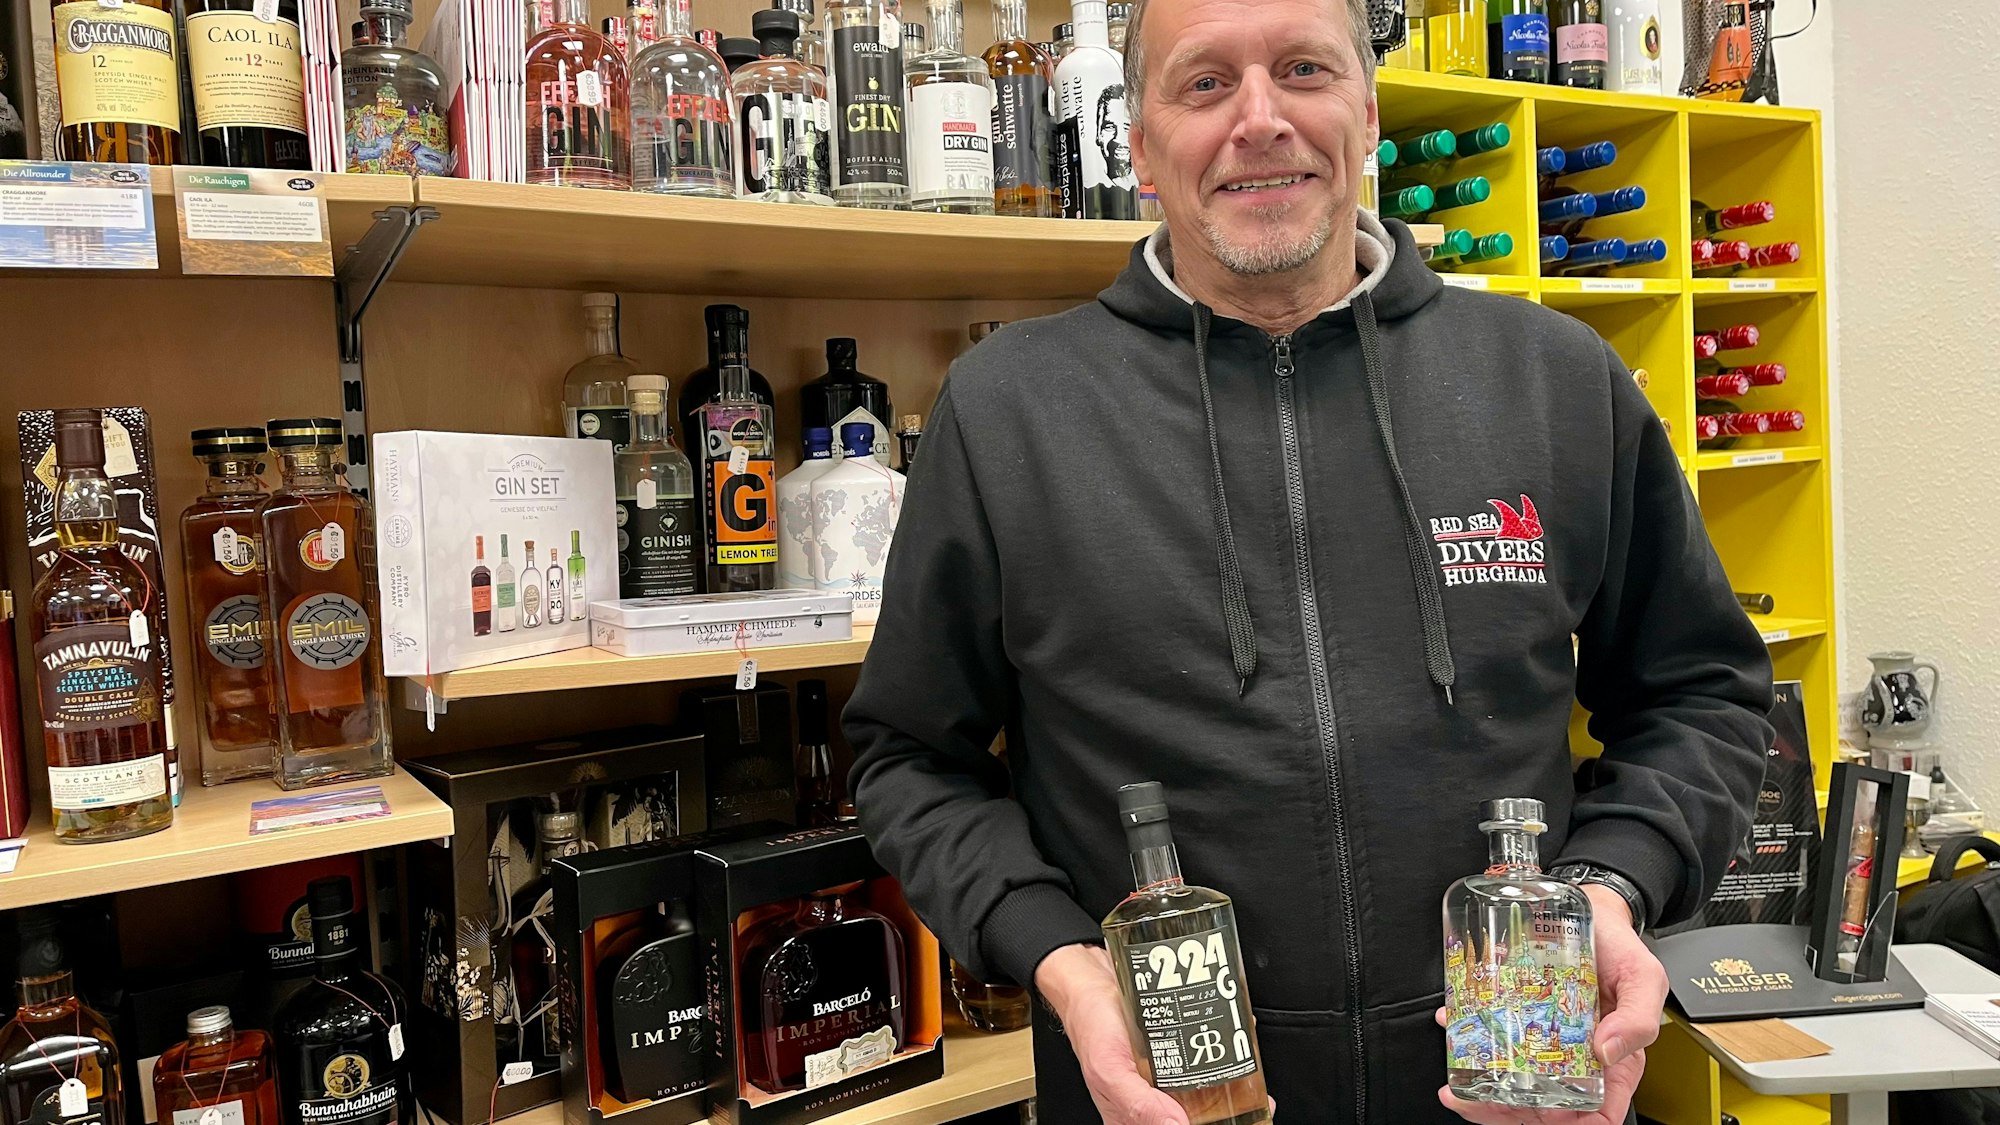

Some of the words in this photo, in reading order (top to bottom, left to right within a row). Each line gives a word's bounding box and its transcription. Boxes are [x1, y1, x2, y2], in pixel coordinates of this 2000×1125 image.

[67, 17, 170, 54] CRAGGANMORE
[207, 26, 262, 44] CAOL
[268, 32, 294, 50] ILA
[92, 55, 106, 68] 12
[246, 53, 263, 67] 12
[129, 72, 152, 80] SINGLE
[846, 103, 902, 133] GIN
[1002, 83, 1017, 150] schwatte
[944, 123, 975, 131] HANDMADE
[675, 118, 731, 172] GIN
[944, 135, 970, 149] DRY
[971, 136, 987, 151] GIN
[879, 156, 901, 164] ALTER
[3, 168, 17, 178] Die
[20, 168, 66, 178] Allrounder
[189, 175, 203, 184] Die
[205, 175, 247, 188] Rauchigen
[511, 460, 543, 472] PREMIUM
[495, 477, 526, 495] GIN
[531, 477, 560, 495] SET
[1430, 517, 1463, 534] RED
[1468, 513, 1500, 530] SEA
[641, 535, 691, 548] GINISH
[720, 549, 758, 559] LEMON
[1437, 540, 1545, 565] DIVERS
[1443, 566, 1547, 587] HURGHADA
[389, 567, 398, 608] COMPANY
[395, 565, 404, 610] DISTILLERY
[686, 618, 796, 635] HAMMERSCHMIEDE
[209, 636, 234, 646] SINGLE
[293, 637, 318, 646] SINGLE
[319, 635, 338, 643] MALT
[339, 632, 366, 641] WHISKY
[43, 640, 149, 671] TAMNAVULIN
[61, 677, 99, 685] SINGLE
[105, 672, 132, 682] MALT
[67, 667, 125, 678] SPEYSIDE
[56, 685, 94, 693] SCOTCH
[99, 678, 139, 689] WHISKY
[65, 695, 104, 704] DOUBLE
[109, 691, 134, 699] CASK
[56, 712, 91, 722] PRODUCT
[65, 769, 143, 784] SCOTLAND
[327, 928, 349, 941] 1881
[1535, 923, 1580, 936] EDITION
[1690, 972, 1794, 990] VILLIGER
[1703, 987, 1720, 995] THE
[1720, 986, 1749, 994] WORLD
[1765, 983, 1793, 991] CIGARS
[710, 937, 723, 1059] IMPERIAL
[813, 987, 871, 1017] BARCELÓ
[1140, 997, 1159, 1007] 500
[1160, 996, 1175, 1005] ML
[1831, 991, 1904, 1004] villigercigars.com
[776, 995, 901, 1043] IMPERIAL
[1142, 1005, 1173, 1019] 42%
[1150, 1039, 1179, 1050] BARREL
[1152, 1050, 1165, 1058] DRY
[1166, 1048, 1180, 1056] GIN
[1153, 1056, 1183, 1069] HAND
[1156, 1067, 1184, 1076] CRAFTED
[299, 1085, 397, 1117] Bunnahabhain
[805, 1099, 824, 1111] RON
[829, 1077, 890, 1103] DOMINICANO
[317, 1113, 337, 1122] SINGLE
[338, 1110, 353, 1119] MALT
[355, 1105, 377, 1116] SCOTCH
